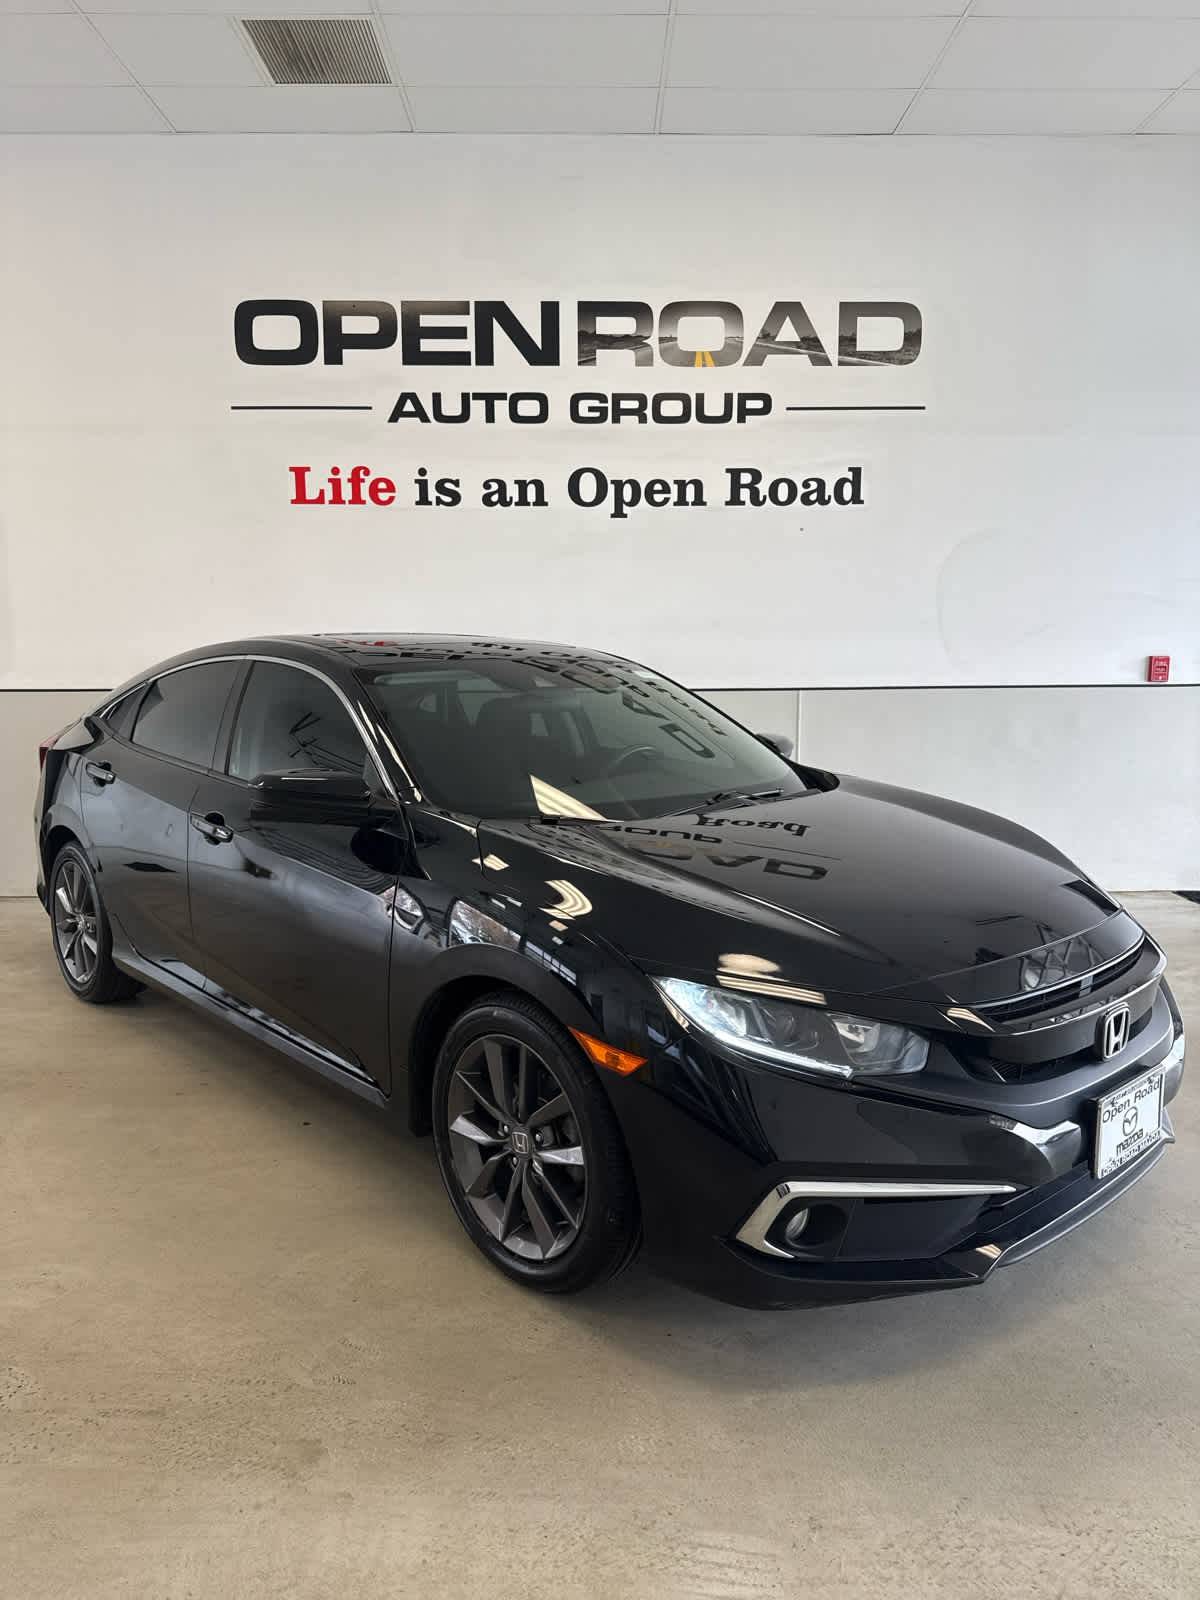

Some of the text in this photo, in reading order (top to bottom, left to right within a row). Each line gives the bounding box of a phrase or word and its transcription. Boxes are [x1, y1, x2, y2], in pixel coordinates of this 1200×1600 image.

[234, 300, 922, 367] OPEN ROAD
[388, 392, 772, 424] AUTO GROUP
[289, 466, 864, 518] Life is an Open Road
[1102, 1098, 1131, 1123] Open
[1134, 1078, 1160, 1103] Road
